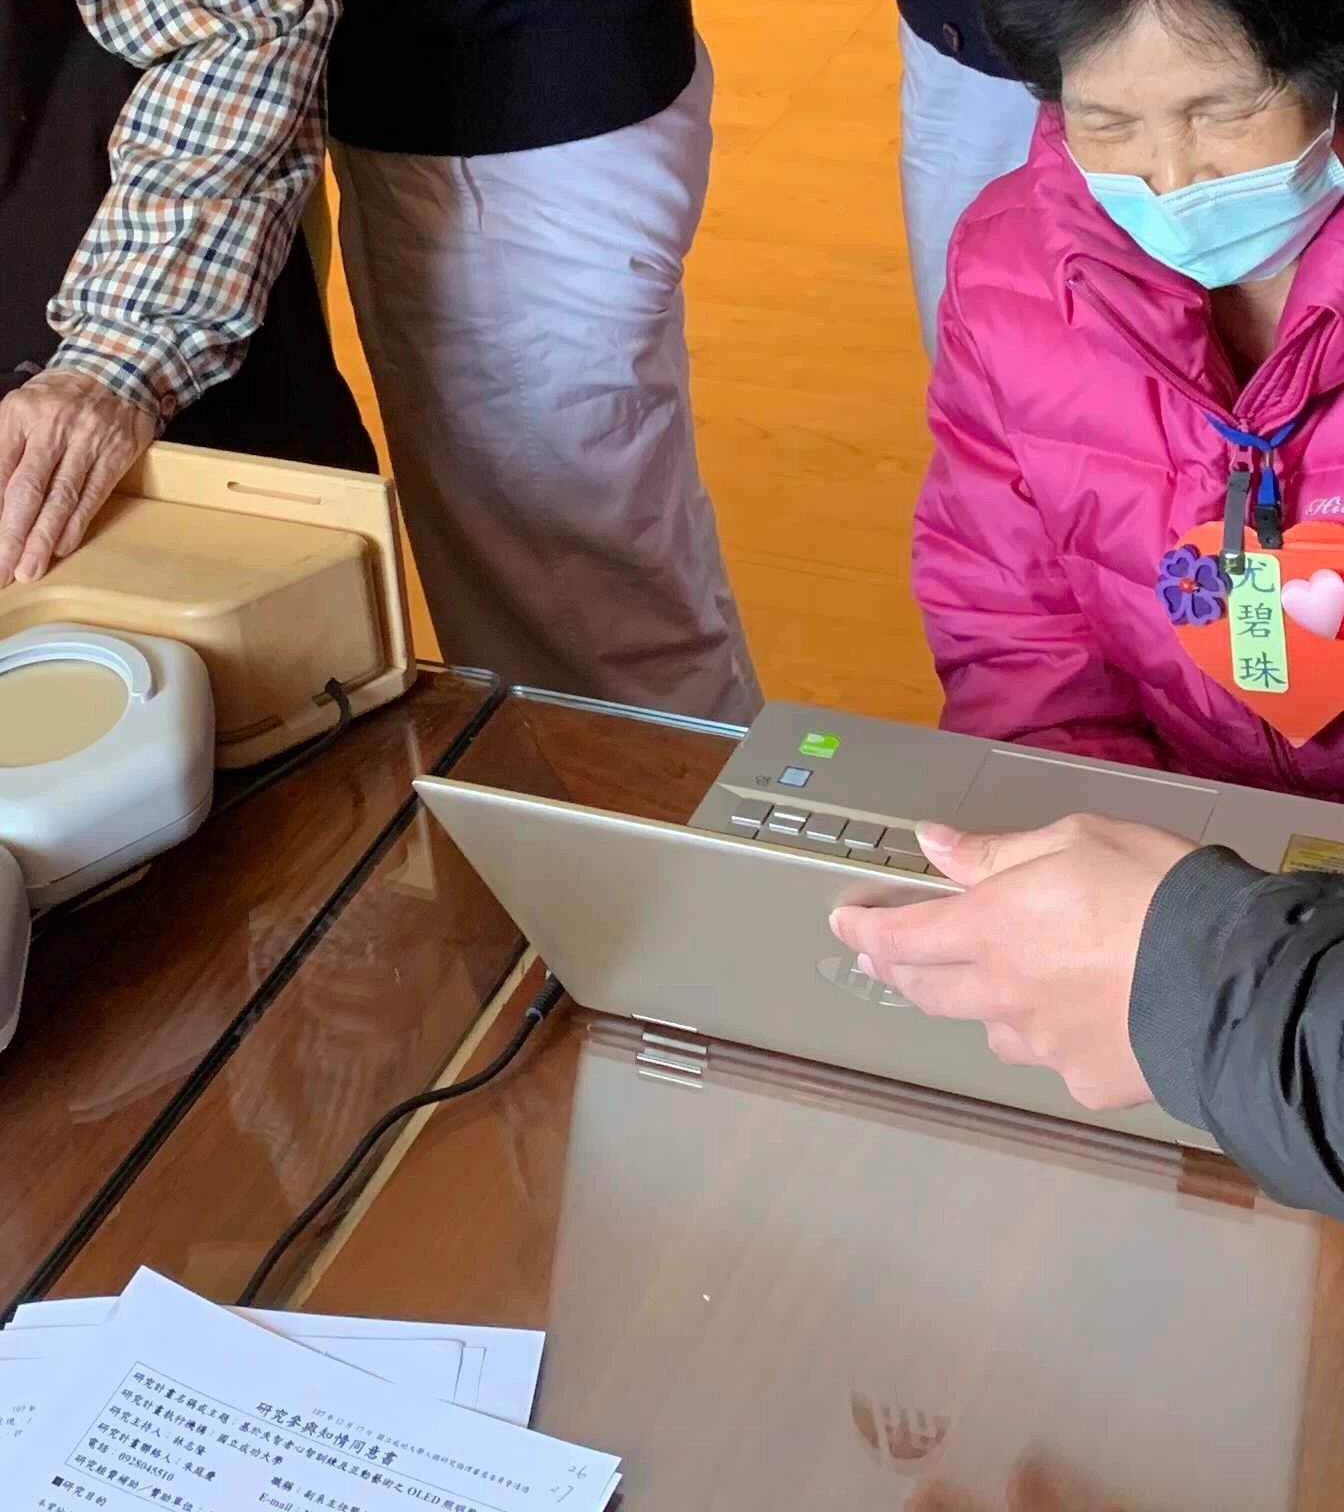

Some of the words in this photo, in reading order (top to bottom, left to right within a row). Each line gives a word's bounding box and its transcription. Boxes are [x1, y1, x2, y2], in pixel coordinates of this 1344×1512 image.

[1235, 557, 1287, 688] 尤碧珠
[407, 1488, 440, 1504] OLED
